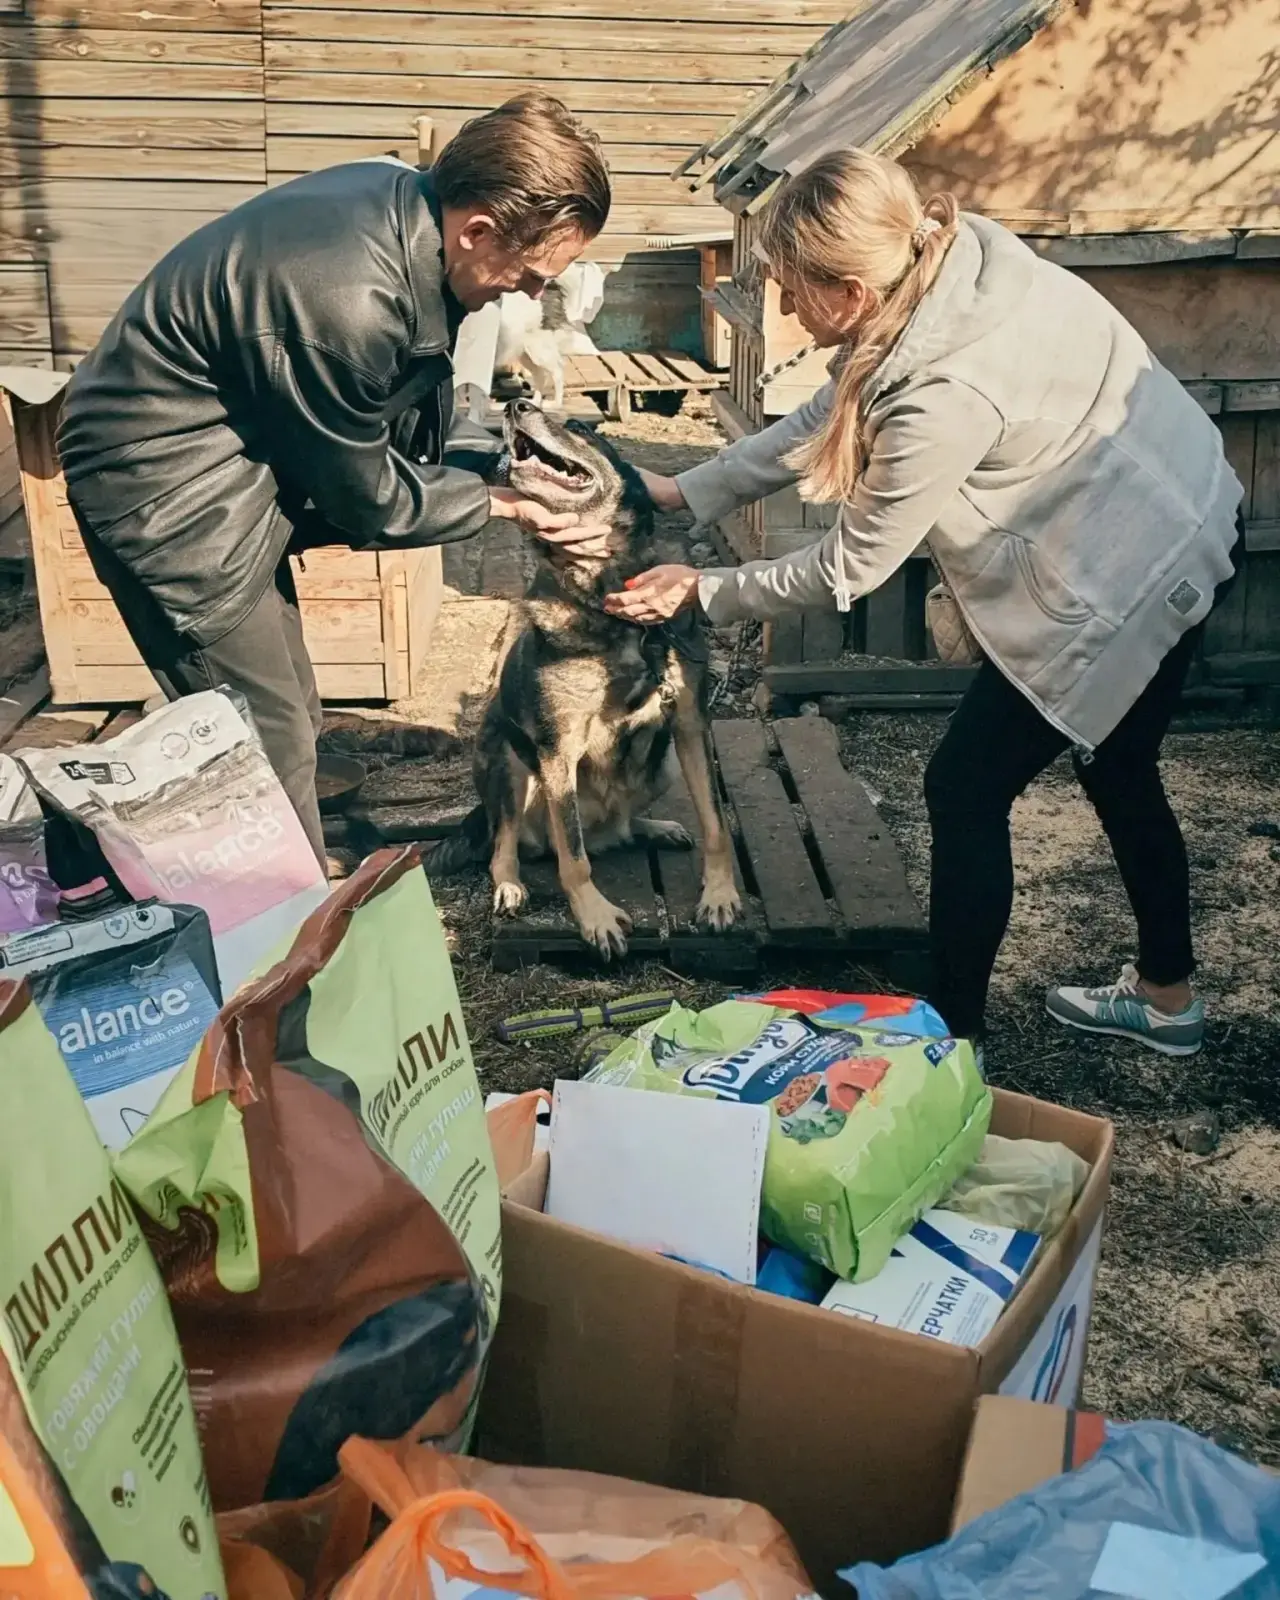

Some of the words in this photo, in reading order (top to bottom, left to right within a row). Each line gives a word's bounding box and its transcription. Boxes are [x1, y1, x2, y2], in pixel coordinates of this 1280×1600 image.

[164, 814, 285, 890] alance
[50, 987, 191, 1054] alance
[93, 1053, 104, 1065] in
[105, 1040, 141, 1062] balance
[142, 1031, 166, 1047] with
[167, 1016, 200, 1037] nature
[441, 1056, 466, 1079] собак
[764, 1058, 799, 1086] КОРМ
[969, 1227, 988, 1242] 50
[4, 1178, 133, 1364] ДИЛЛИ
[103, 1258, 122, 1287] для
[918, 1275, 969, 1338] ЕРЧАТКИ
